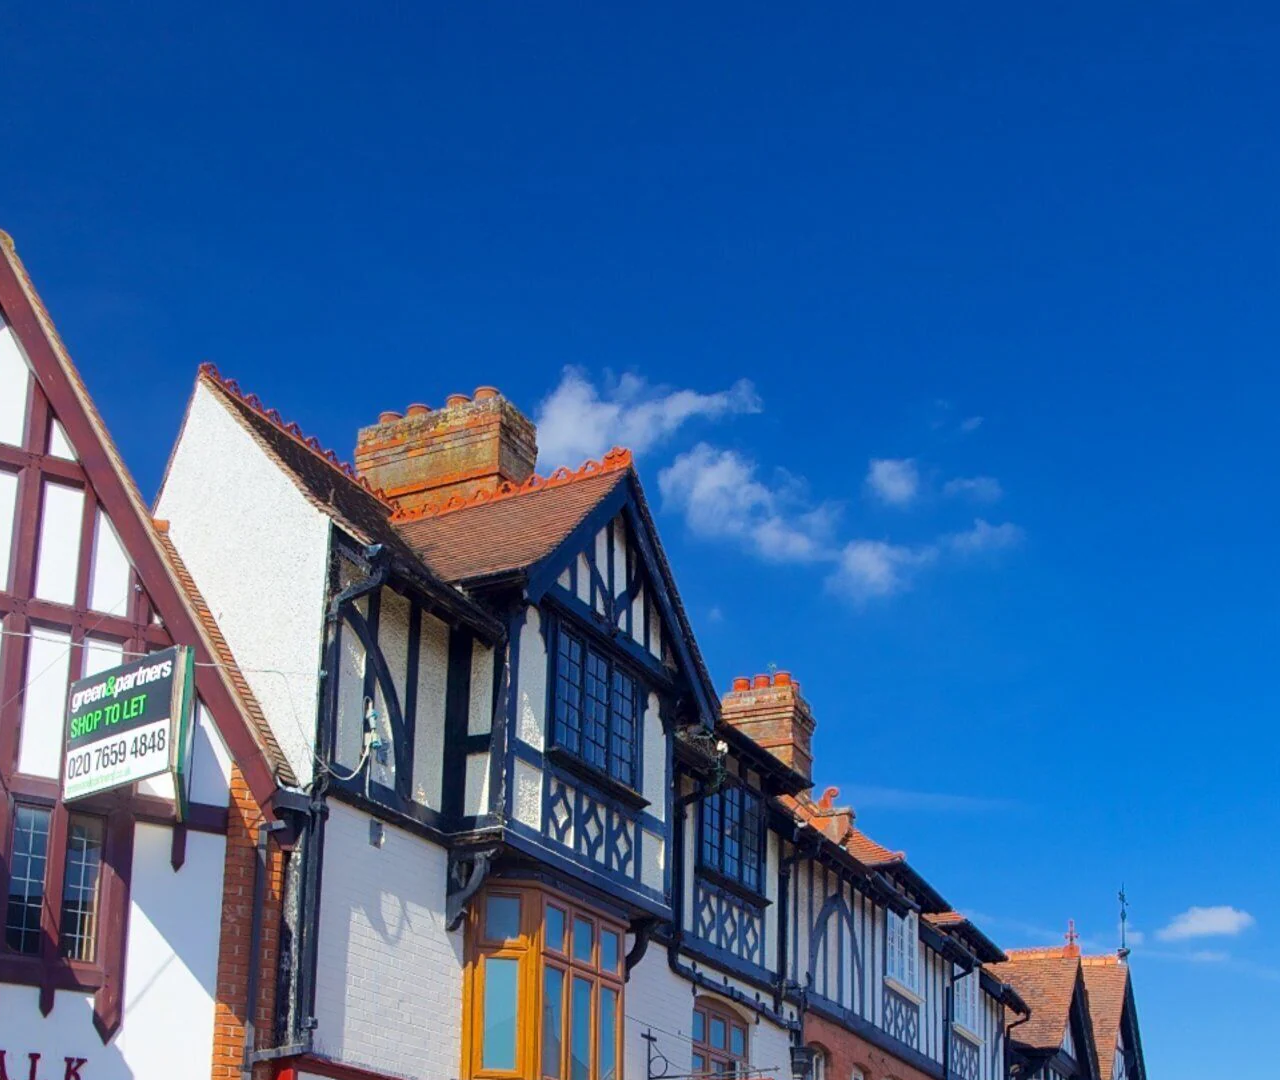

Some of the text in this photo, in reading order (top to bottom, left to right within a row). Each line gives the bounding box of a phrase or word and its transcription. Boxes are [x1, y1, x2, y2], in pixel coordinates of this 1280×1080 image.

[72, 660, 173, 713] green&partners
[71, 694, 147, 738] SHOP TO LET
[68, 752, 91, 779] 020
[95, 740, 127, 770] 7659
[130, 728, 166, 759] 4848
